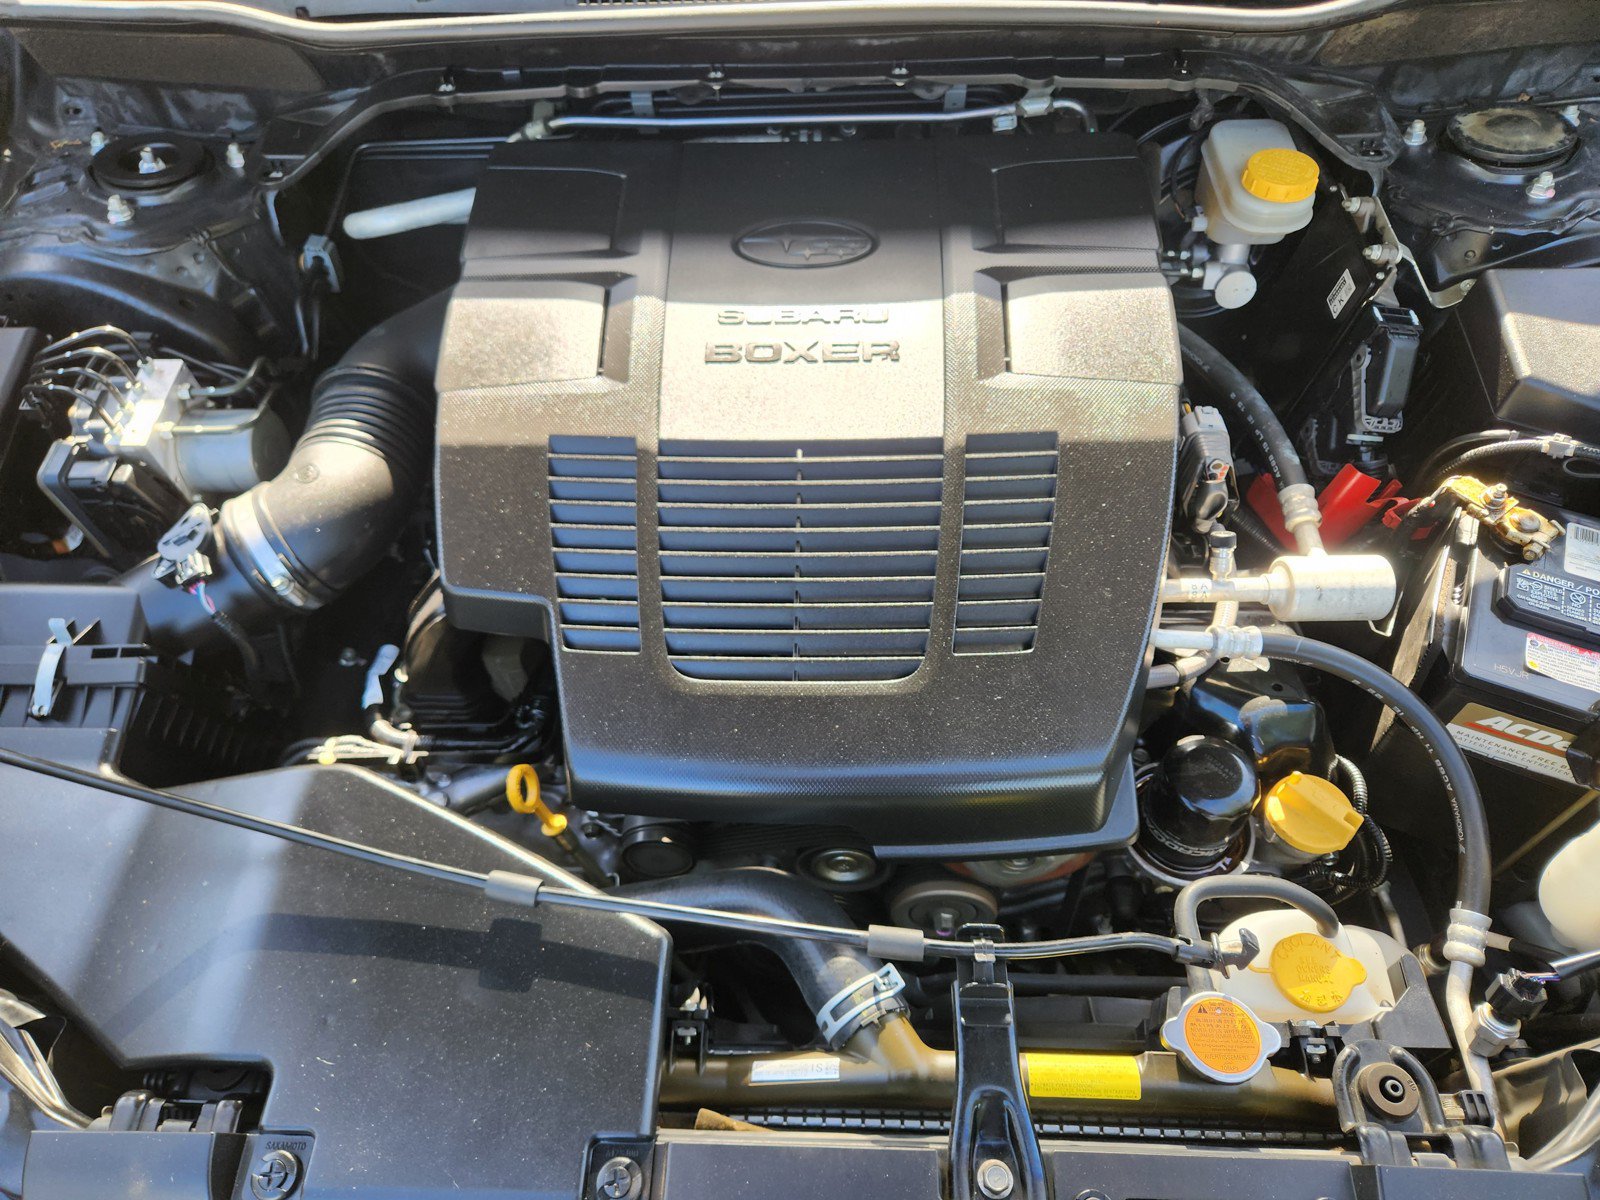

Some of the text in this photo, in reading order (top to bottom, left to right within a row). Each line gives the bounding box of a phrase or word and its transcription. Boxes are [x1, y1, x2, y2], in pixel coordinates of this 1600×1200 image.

[717, 309, 889, 325] SUBARU
[704, 340, 901, 363] BOXER
[1532, 571, 1575, 589] DANGER
[1456, 730, 1528, 757] MAINTENANCE
[1531, 754, 1558, 767] FREE
[1495, 748, 1519, 760] SANS
[1521, 756, 1571, 776] ENTRETIEN
[1450, 797, 1465, 841] YOKOHAMA
[1276, 936, 1342, 960] COOLANT
[265, 1141, 307, 1150] SAKAMOTO
